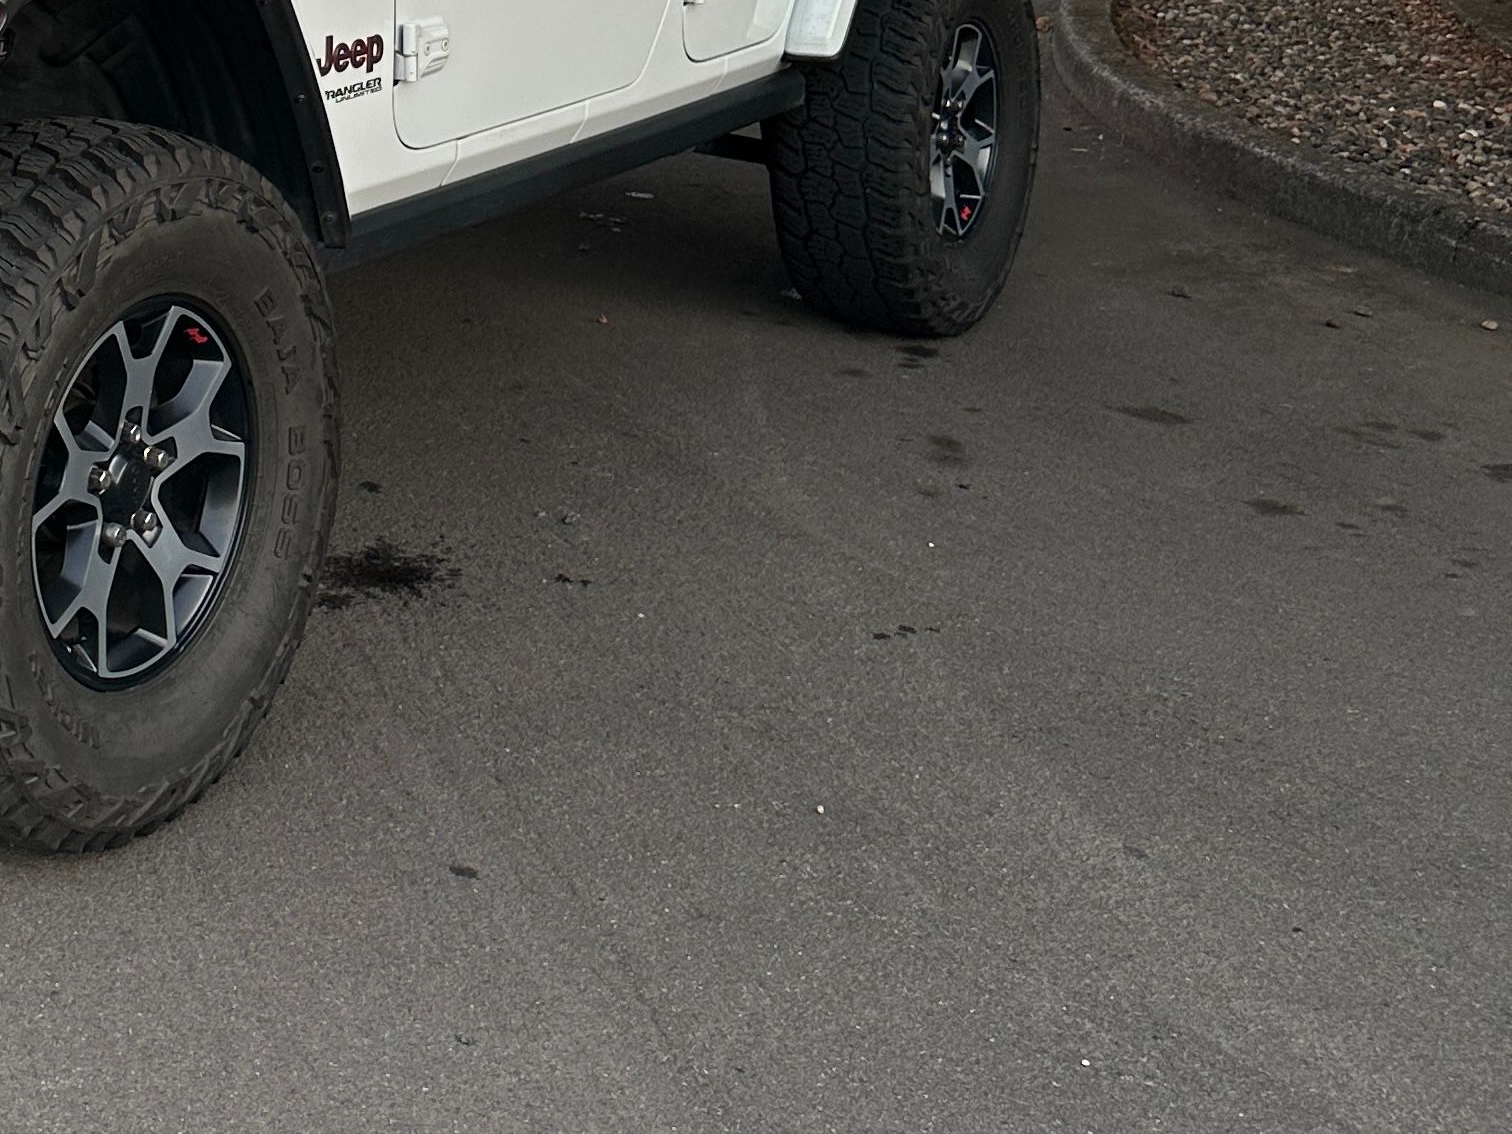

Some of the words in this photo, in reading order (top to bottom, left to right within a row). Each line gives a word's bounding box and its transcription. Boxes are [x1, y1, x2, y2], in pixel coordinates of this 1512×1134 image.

[316, 34, 384, 77] Jeep
[253, 286, 300, 395] BAJA
[273, 425, 308, 560] BOSS
